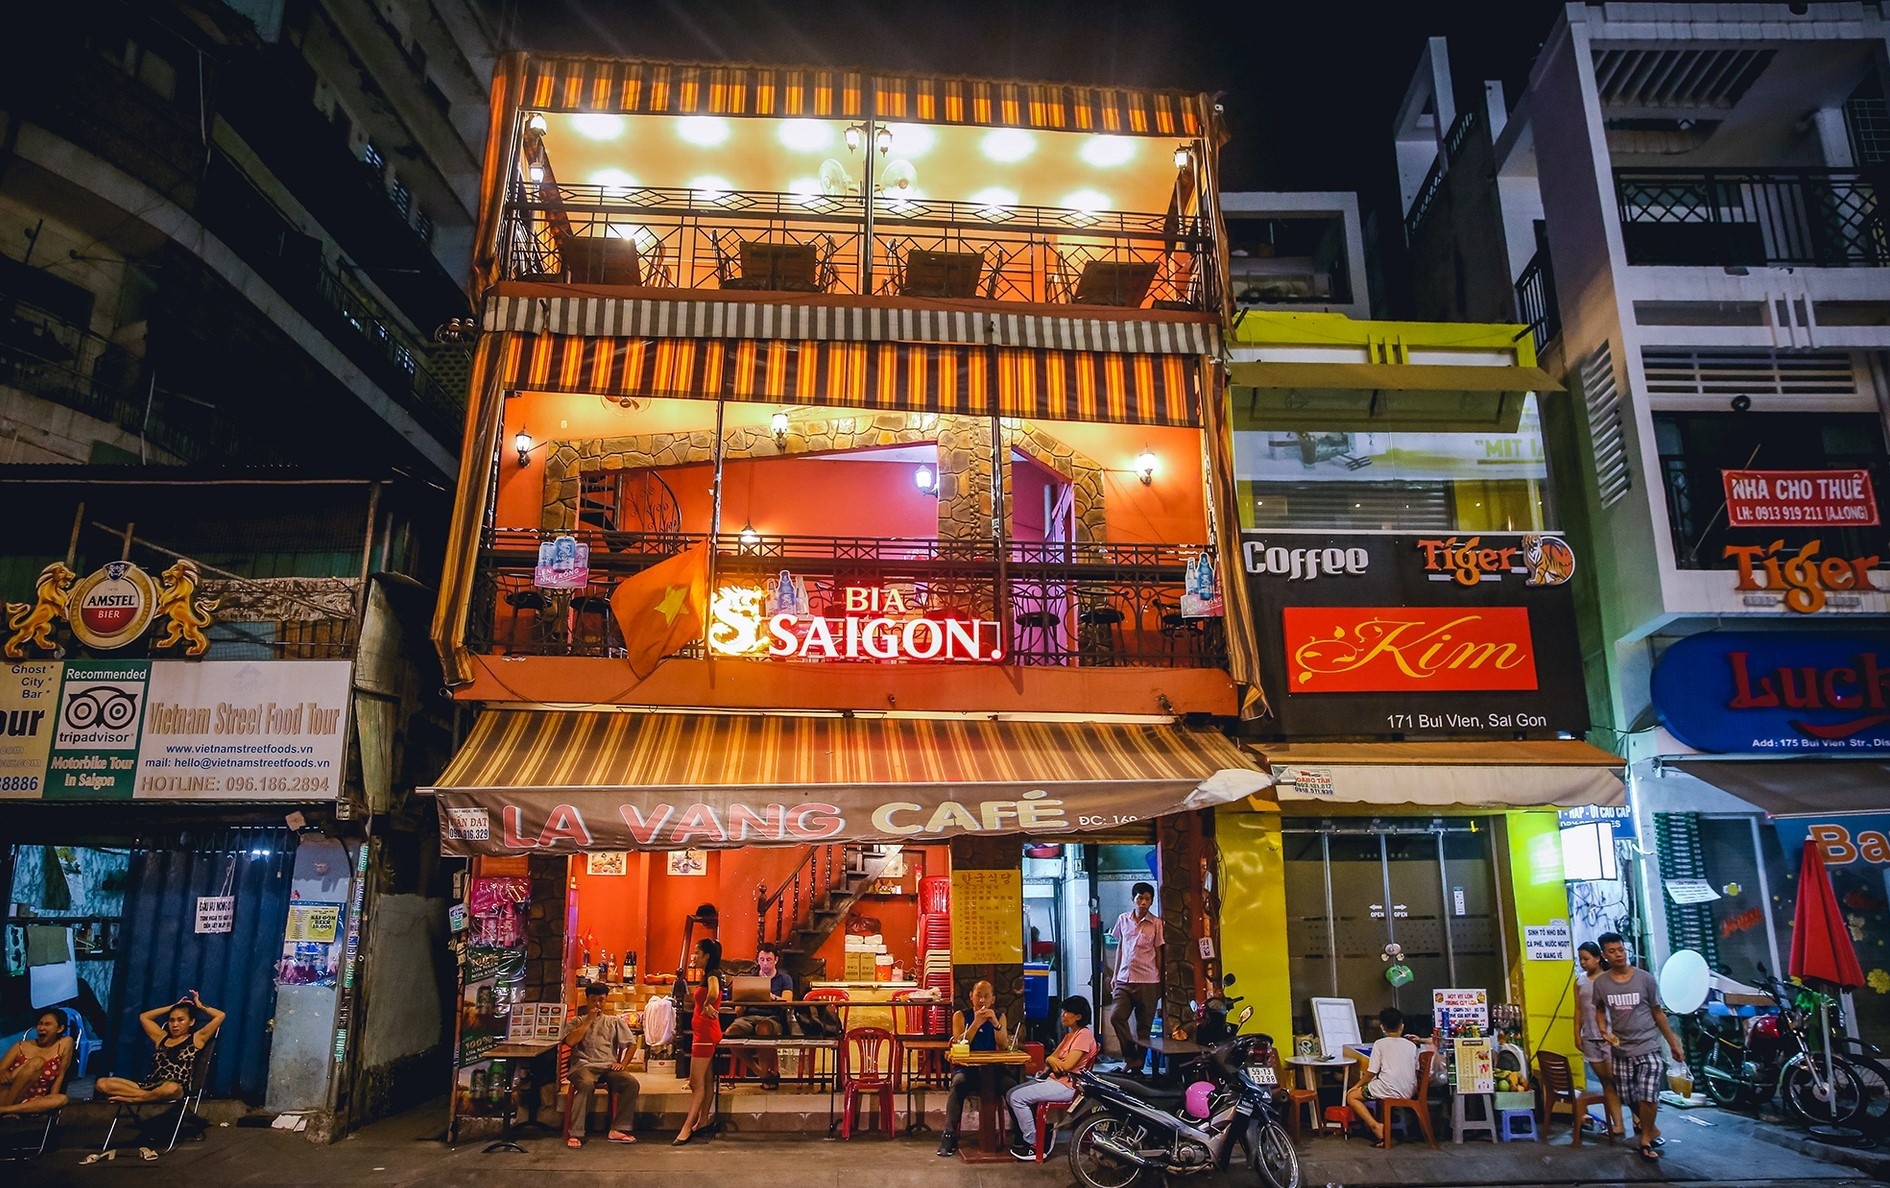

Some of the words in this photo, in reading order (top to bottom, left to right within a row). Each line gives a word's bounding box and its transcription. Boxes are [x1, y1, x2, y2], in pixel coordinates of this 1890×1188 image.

[1731, 475, 1770, 500] NHÀ
[1775, 479, 1813, 500] CHO
[1816, 474, 1865, 500] THUÊ
[1737, 506, 1753, 520] LH:
[1755, 506, 1781, 520] 0913
[1783, 506, 1801, 520] 919
[1803, 506, 1823, 520] 211
[1243, 541, 1369, 582] Coffee
[1416, 536, 1518, 587] Tiger
[1723, 539, 1880, 613] Tiger
[87, 595, 135, 606] AMSTEL
[846, 586, 906, 613] BIA
[98, 610, 120, 619] BIER
[1295, 614, 1527, 684] Kim
[11, 664, 47, 674] Ghost
[66, 668, 147, 680] Recommended
[21, 677, 45, 688] City
[22, 689, 43, 699] Bar
[147, 702, 211, 735] Vietnam
[215, 702, 263, 735] Street
[266, 702, 303, 735] Food
[307, 702, 341, 735] Tour
[1387, 715, 1413, 728] 171
[1516, 713, 1547, 727] Gon
[59, 732, 129, 744] tripadvisor
[1752, 739, 1778, 747] Add:
[1780, 739, 1799, 747] 175
[166, 744, 313, 754] www.vietnamstreetfoods.vn
[51, 755, 107, 770] Motorbike
[110, 756, 134, 769] Tour
[145, 757, 171, 768] mail:
[174, 757, 330, 770] hello@vietnamstreetfoods.vn
[0, 776, 38, 791] 8886
[65, 773, 76, 786] In
[79, 773, 116, 790] Saigon
[141, 776, 221, 792] HOTLINE:
[226, 776, 329, 792] 096.186.2894
[502, 803, 594, 849] LA
[618, 801, 847, 845] VANG
[870, 789, 1070, 836] CAFÉ
[1078, 815, 1107, 826] ĐC:
[1807, 824, 1890, 865] Ba
[1607, 992, 1640, 1006] PUMA
[465, 1035, 493, 1050] 100%
